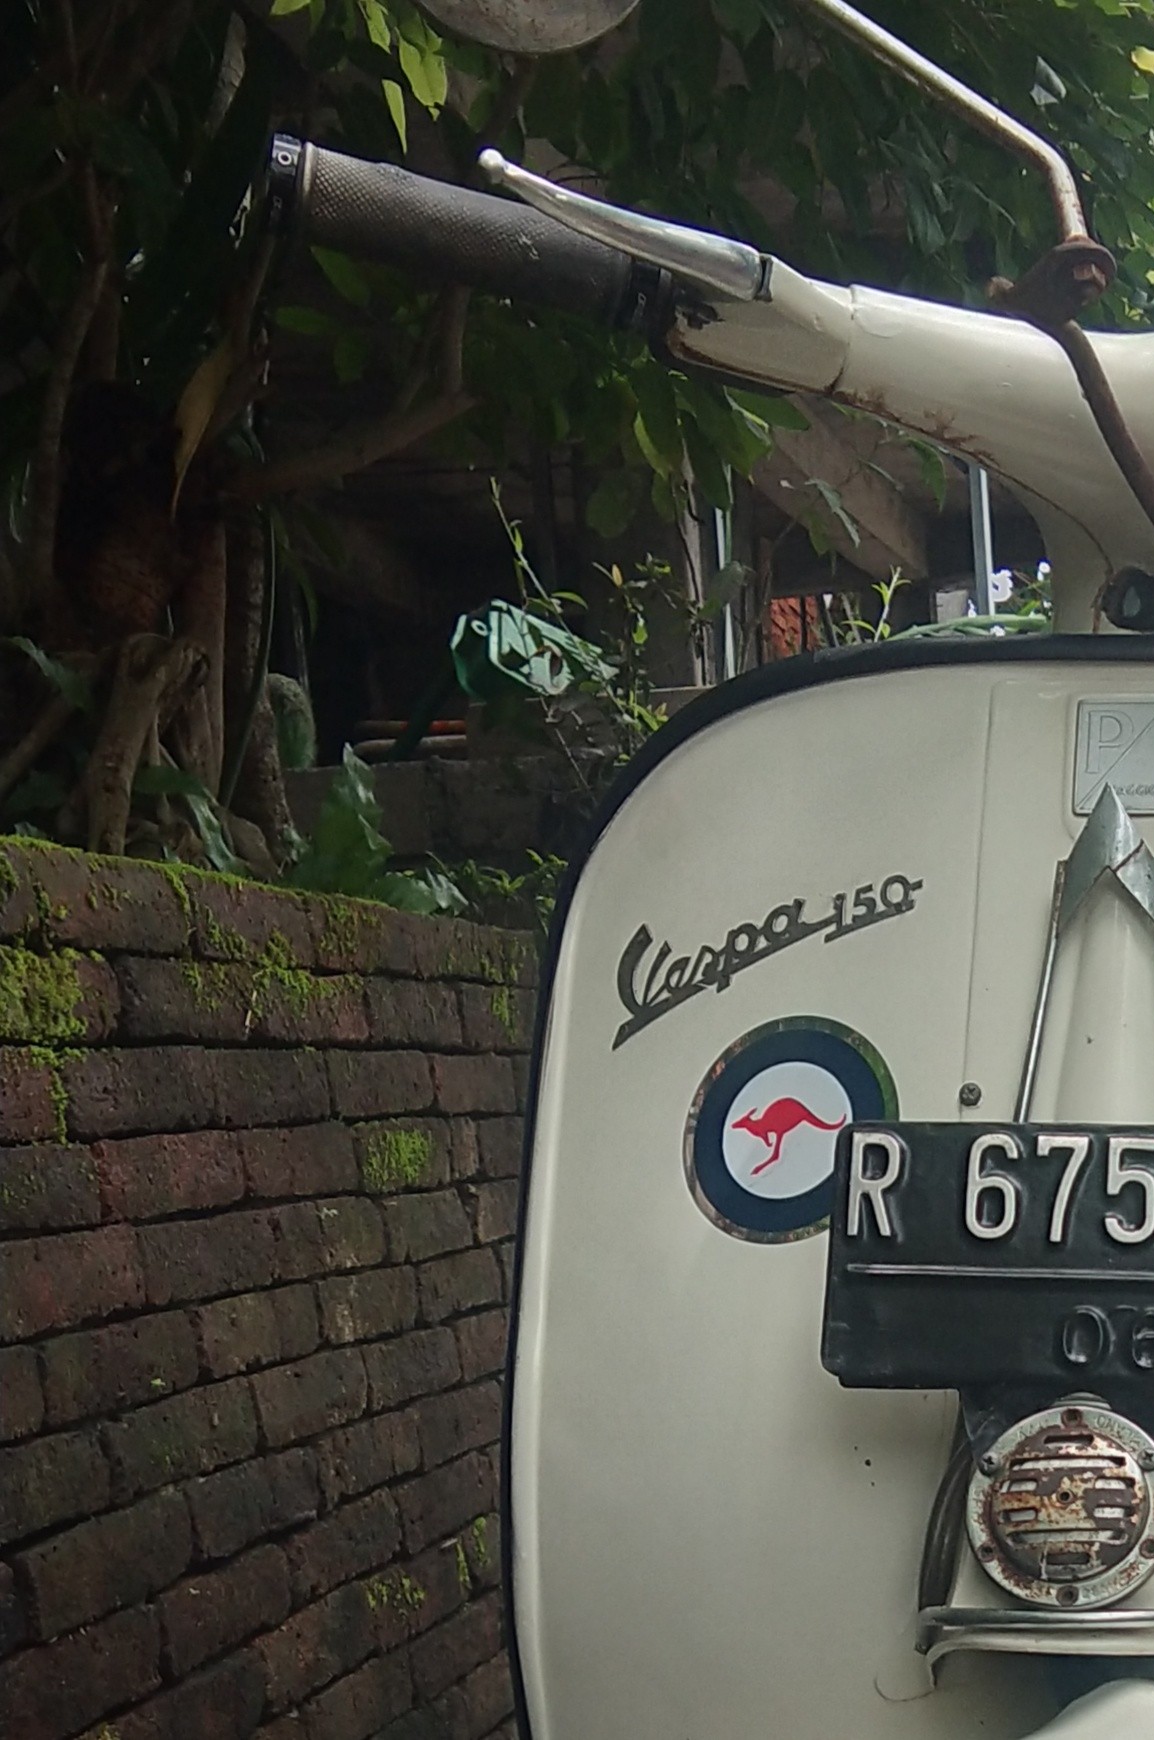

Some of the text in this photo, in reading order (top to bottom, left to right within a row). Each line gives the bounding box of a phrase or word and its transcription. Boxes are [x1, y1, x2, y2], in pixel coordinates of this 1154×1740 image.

[611, 874, 924, 1051] Vespa 150
[847, 1132, 902, 1237] R
